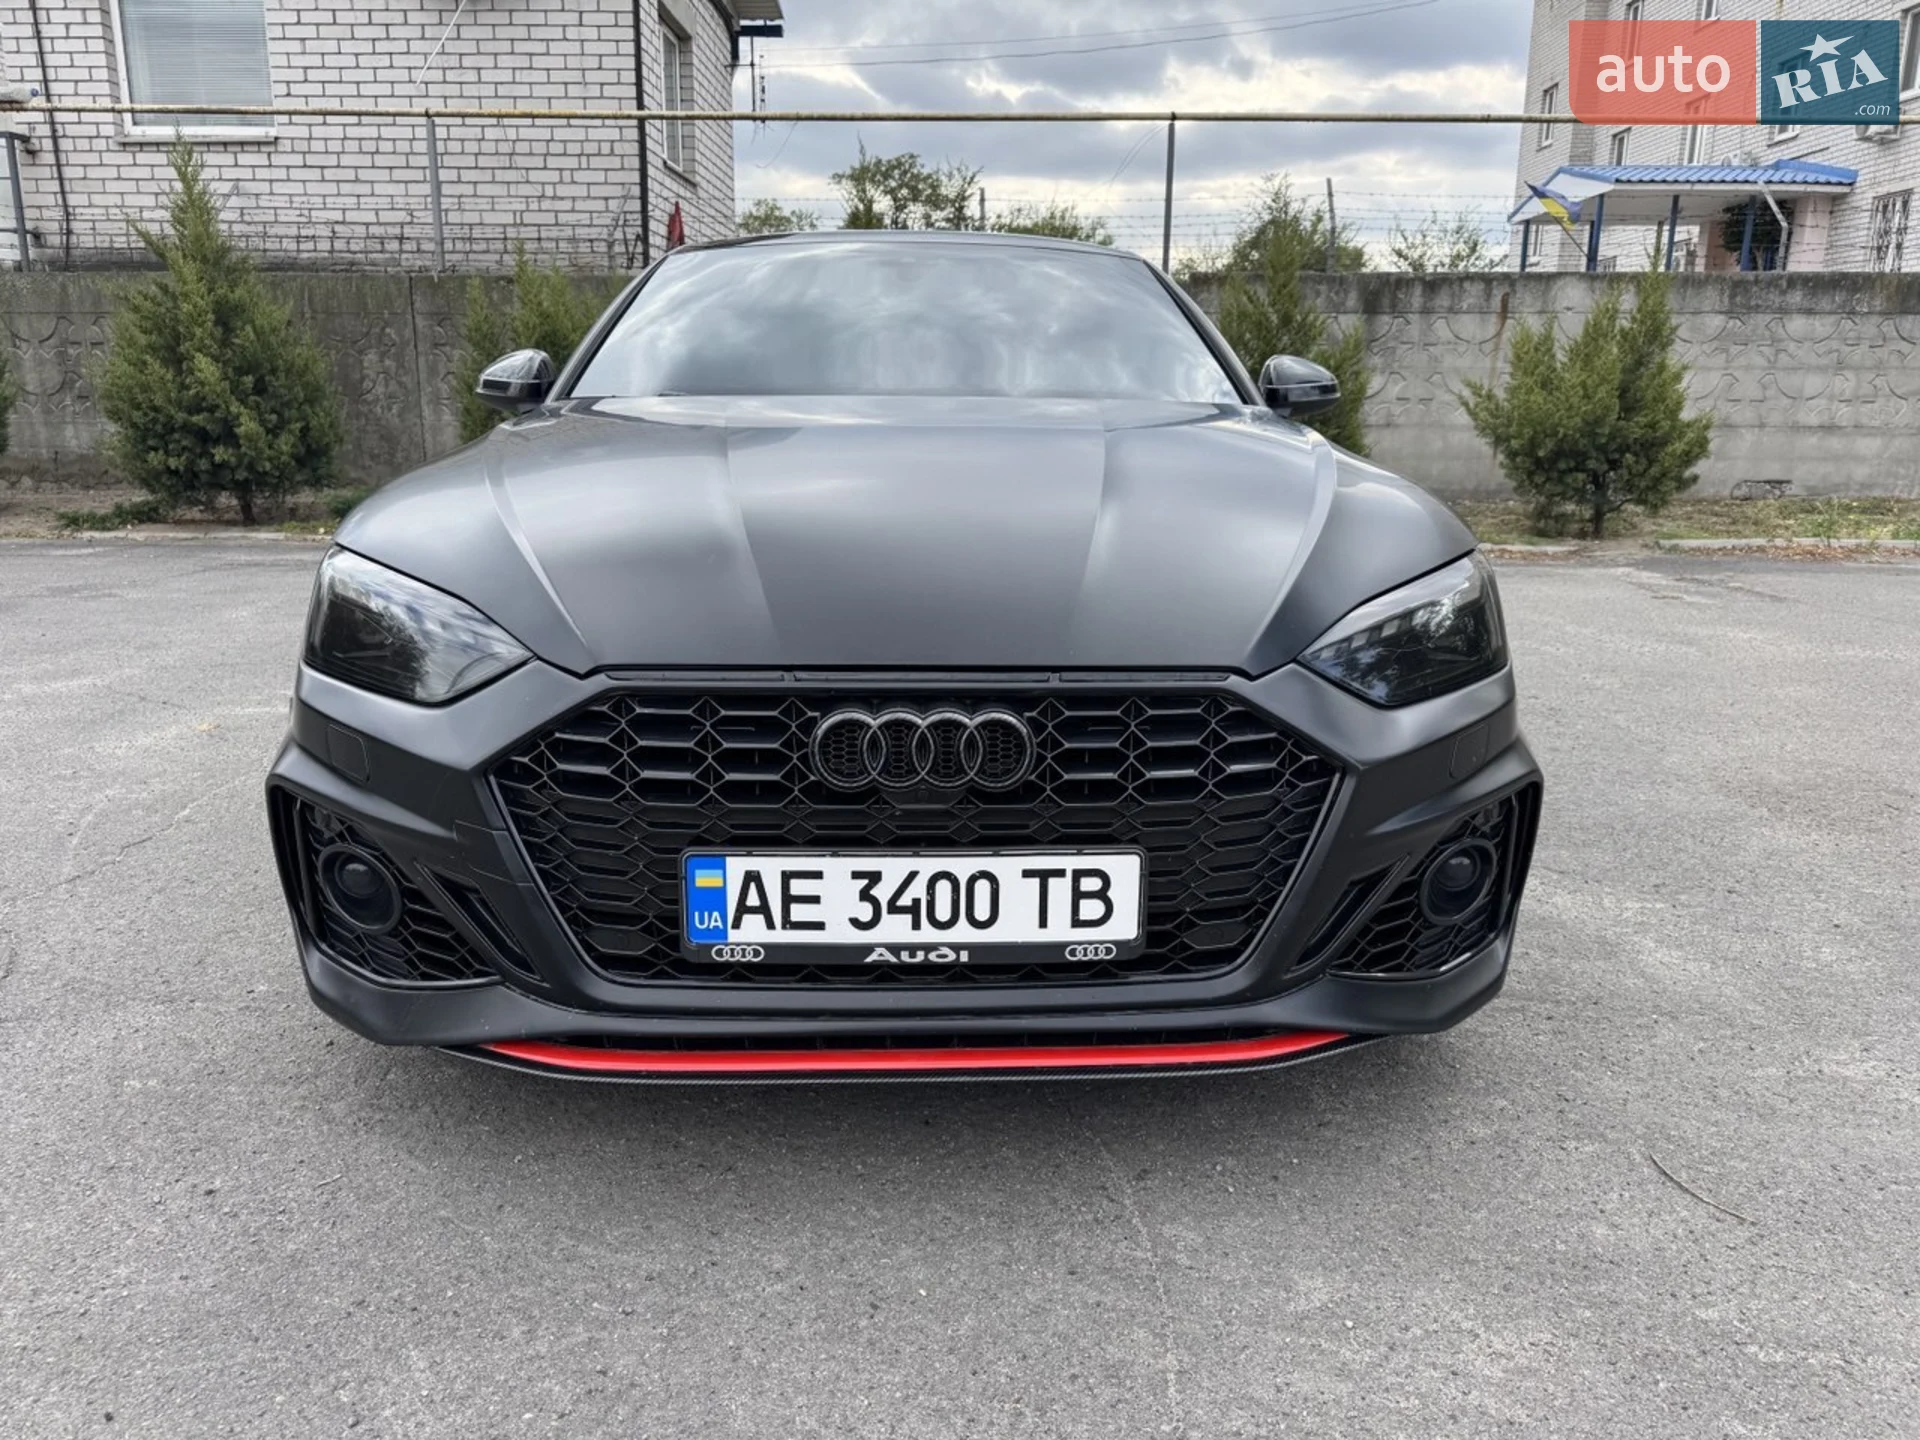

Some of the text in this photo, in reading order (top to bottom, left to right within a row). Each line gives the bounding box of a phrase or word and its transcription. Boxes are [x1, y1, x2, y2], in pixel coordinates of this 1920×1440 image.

[730, 867, 1115, 931] AE 3400 TB
[694, 912, 724, 931] UA
[863, 947, 970, 964] Audi
